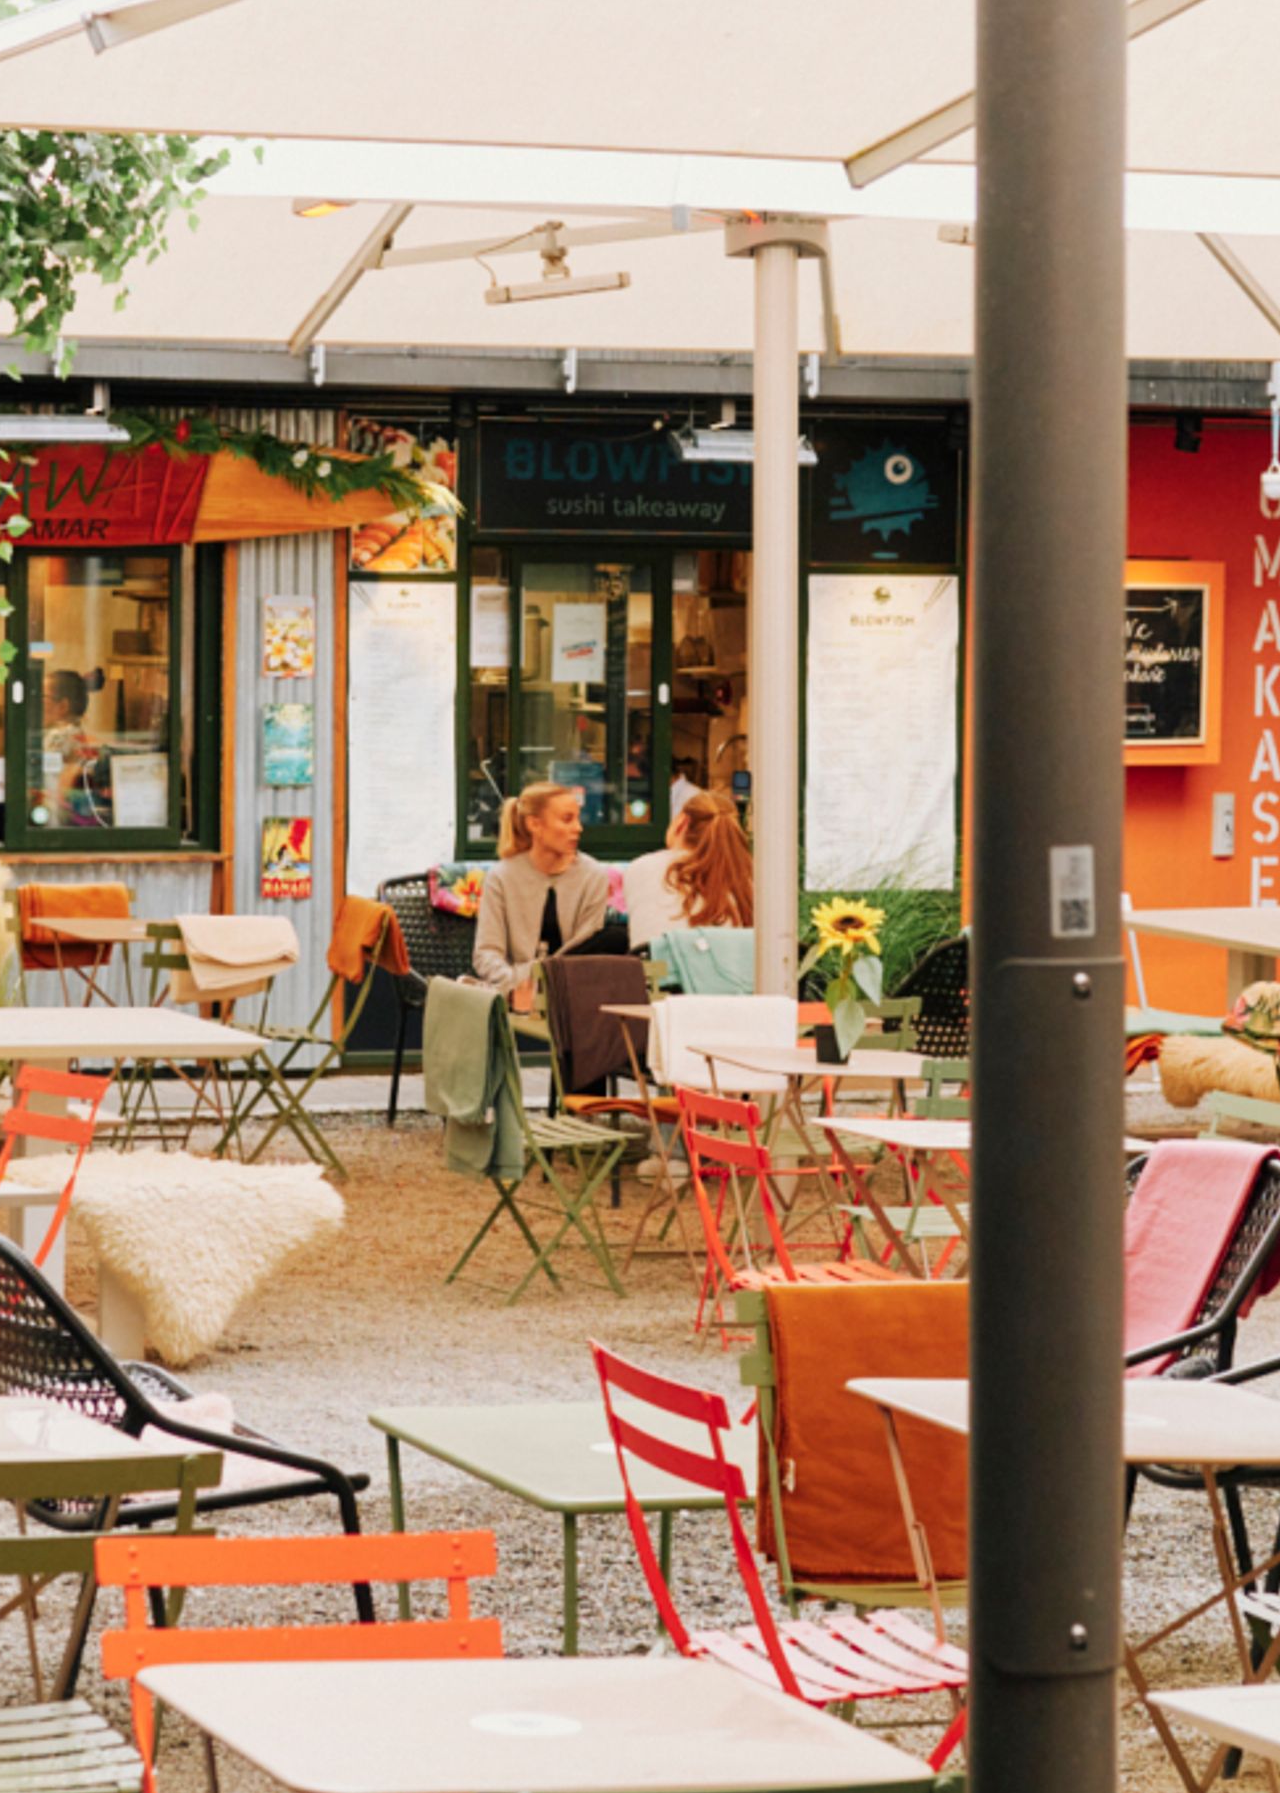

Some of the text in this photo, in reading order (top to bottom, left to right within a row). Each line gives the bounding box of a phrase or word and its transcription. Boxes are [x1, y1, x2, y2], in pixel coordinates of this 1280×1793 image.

[504, 438, 753, 486] BLOWFIS
[546, 493, 726, 523] sushi takeaway
